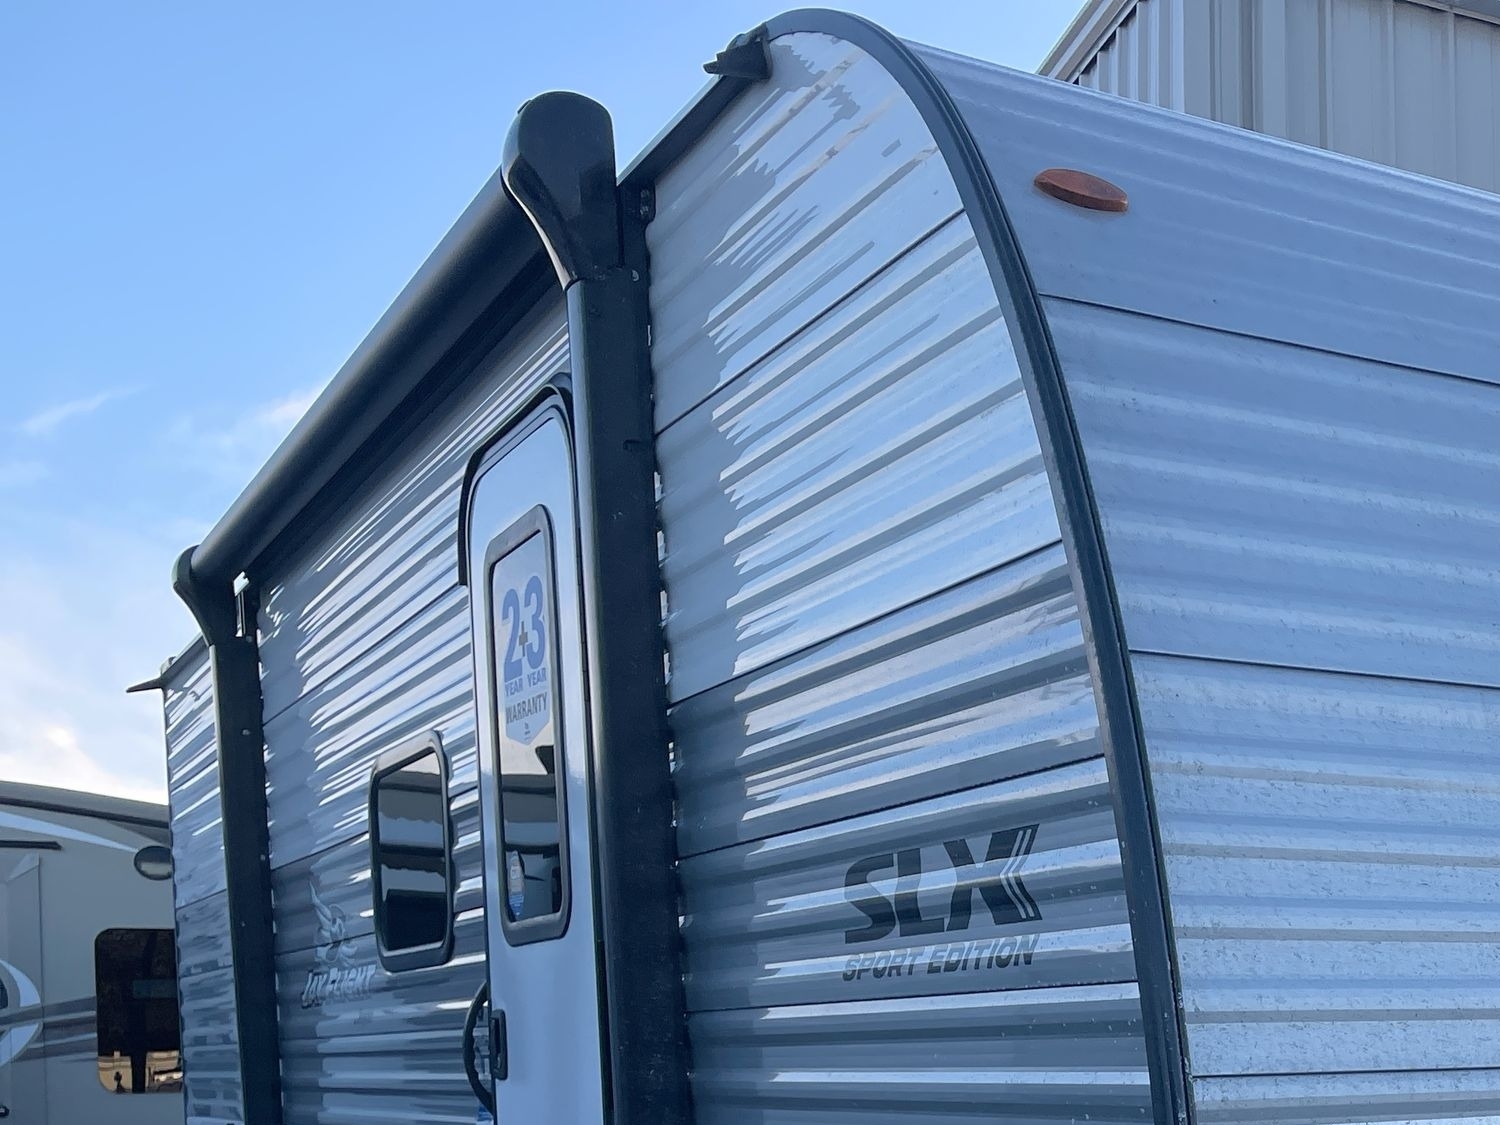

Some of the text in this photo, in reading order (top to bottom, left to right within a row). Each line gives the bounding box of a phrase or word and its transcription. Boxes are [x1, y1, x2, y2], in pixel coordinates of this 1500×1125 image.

[505, 667, 547, 697] YEAR YEAR
[506, 692, 548, 725] WARRANTY
[844, 824, 1042, 944] SLX
[842, 934, 1040, 981] SPORT EDITION
